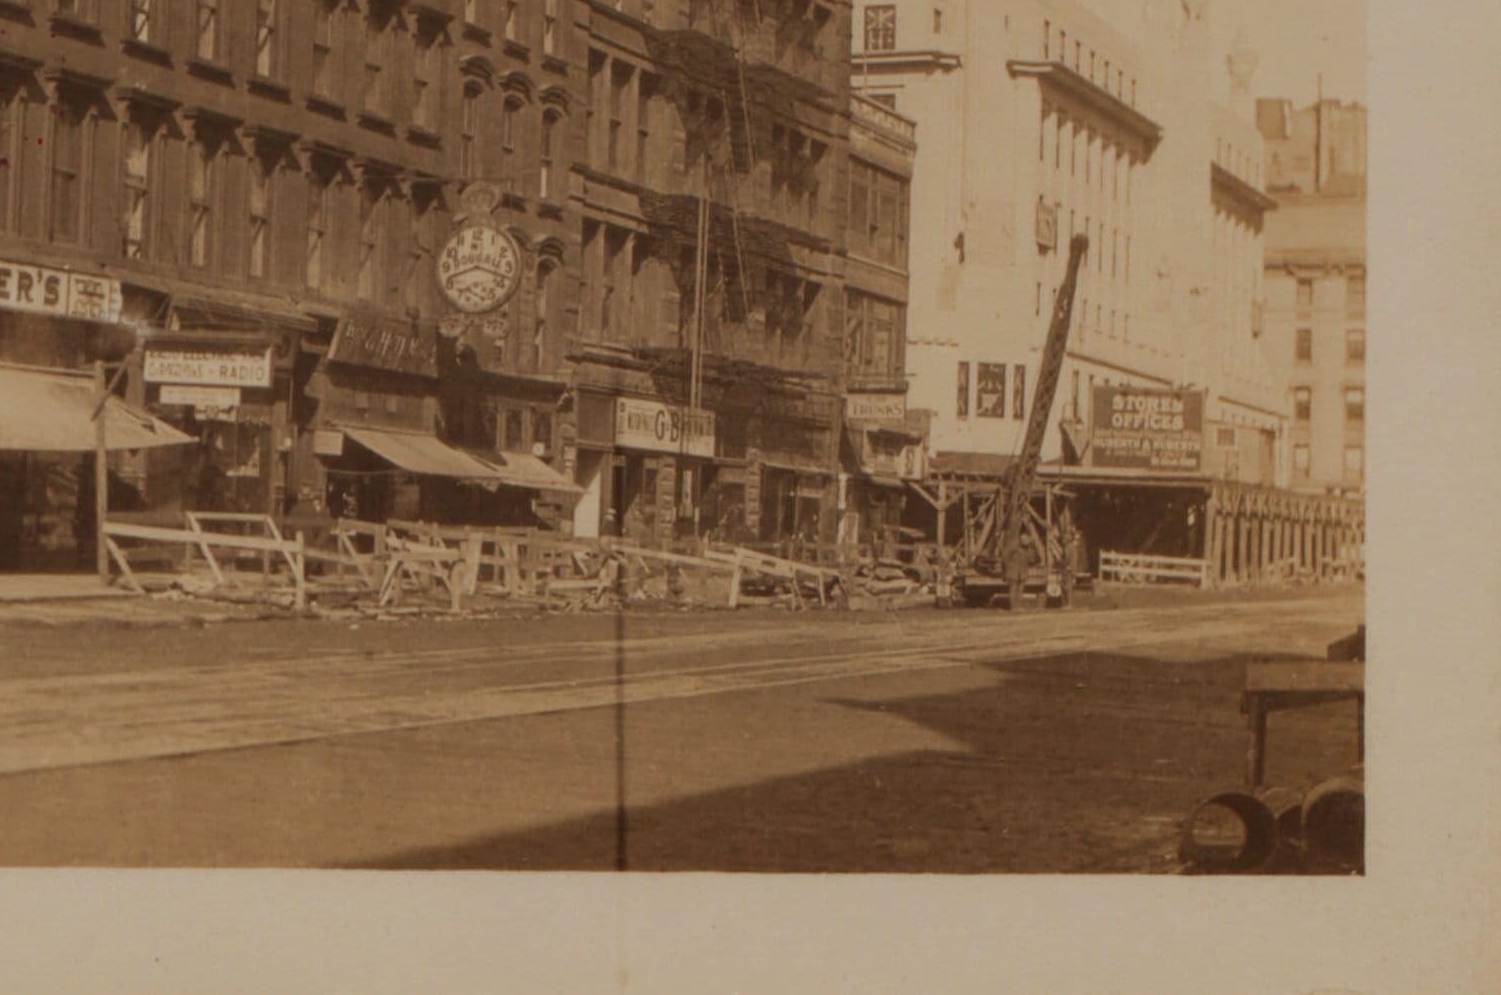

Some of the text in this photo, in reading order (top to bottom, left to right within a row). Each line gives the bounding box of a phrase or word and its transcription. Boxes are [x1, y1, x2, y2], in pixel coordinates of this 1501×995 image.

[219, 365, 265, 382] RADIO
[1112, 393, 1184, 413] STORES
[1111, 412, 1185, 431] OFFICES
